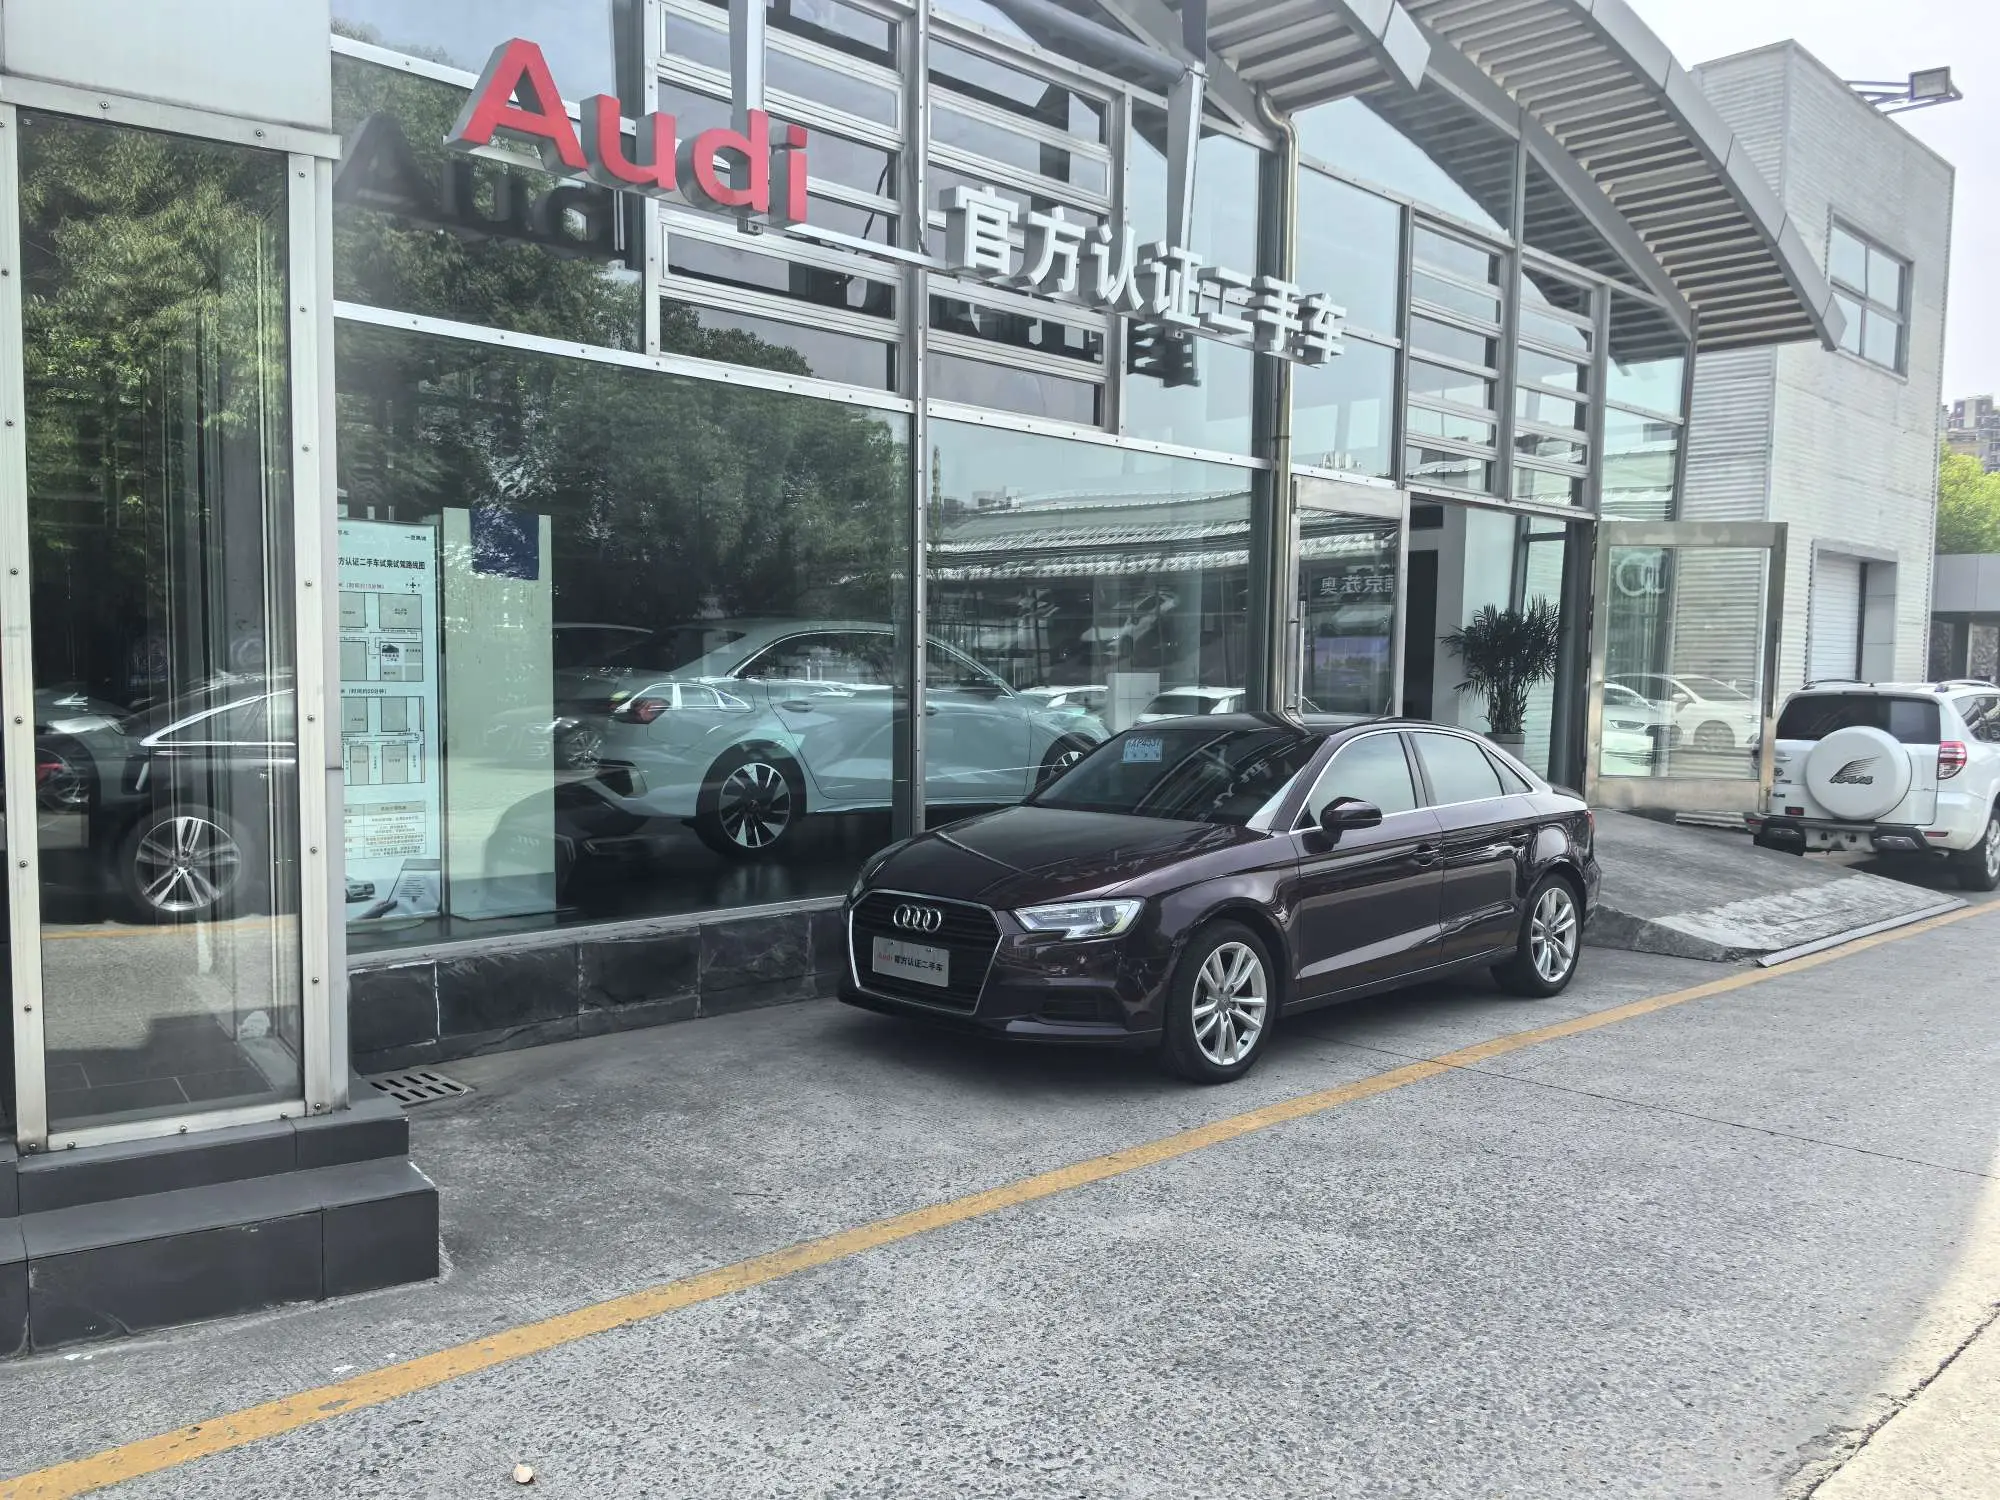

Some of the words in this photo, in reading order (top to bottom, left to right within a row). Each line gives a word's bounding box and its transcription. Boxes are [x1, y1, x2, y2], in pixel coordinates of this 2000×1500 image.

[445, 38, 808, 225] Audi
[939, 185, 1347, 368] 官方认证二手车
[895, 955, 943, 971] 官方认证二手车
